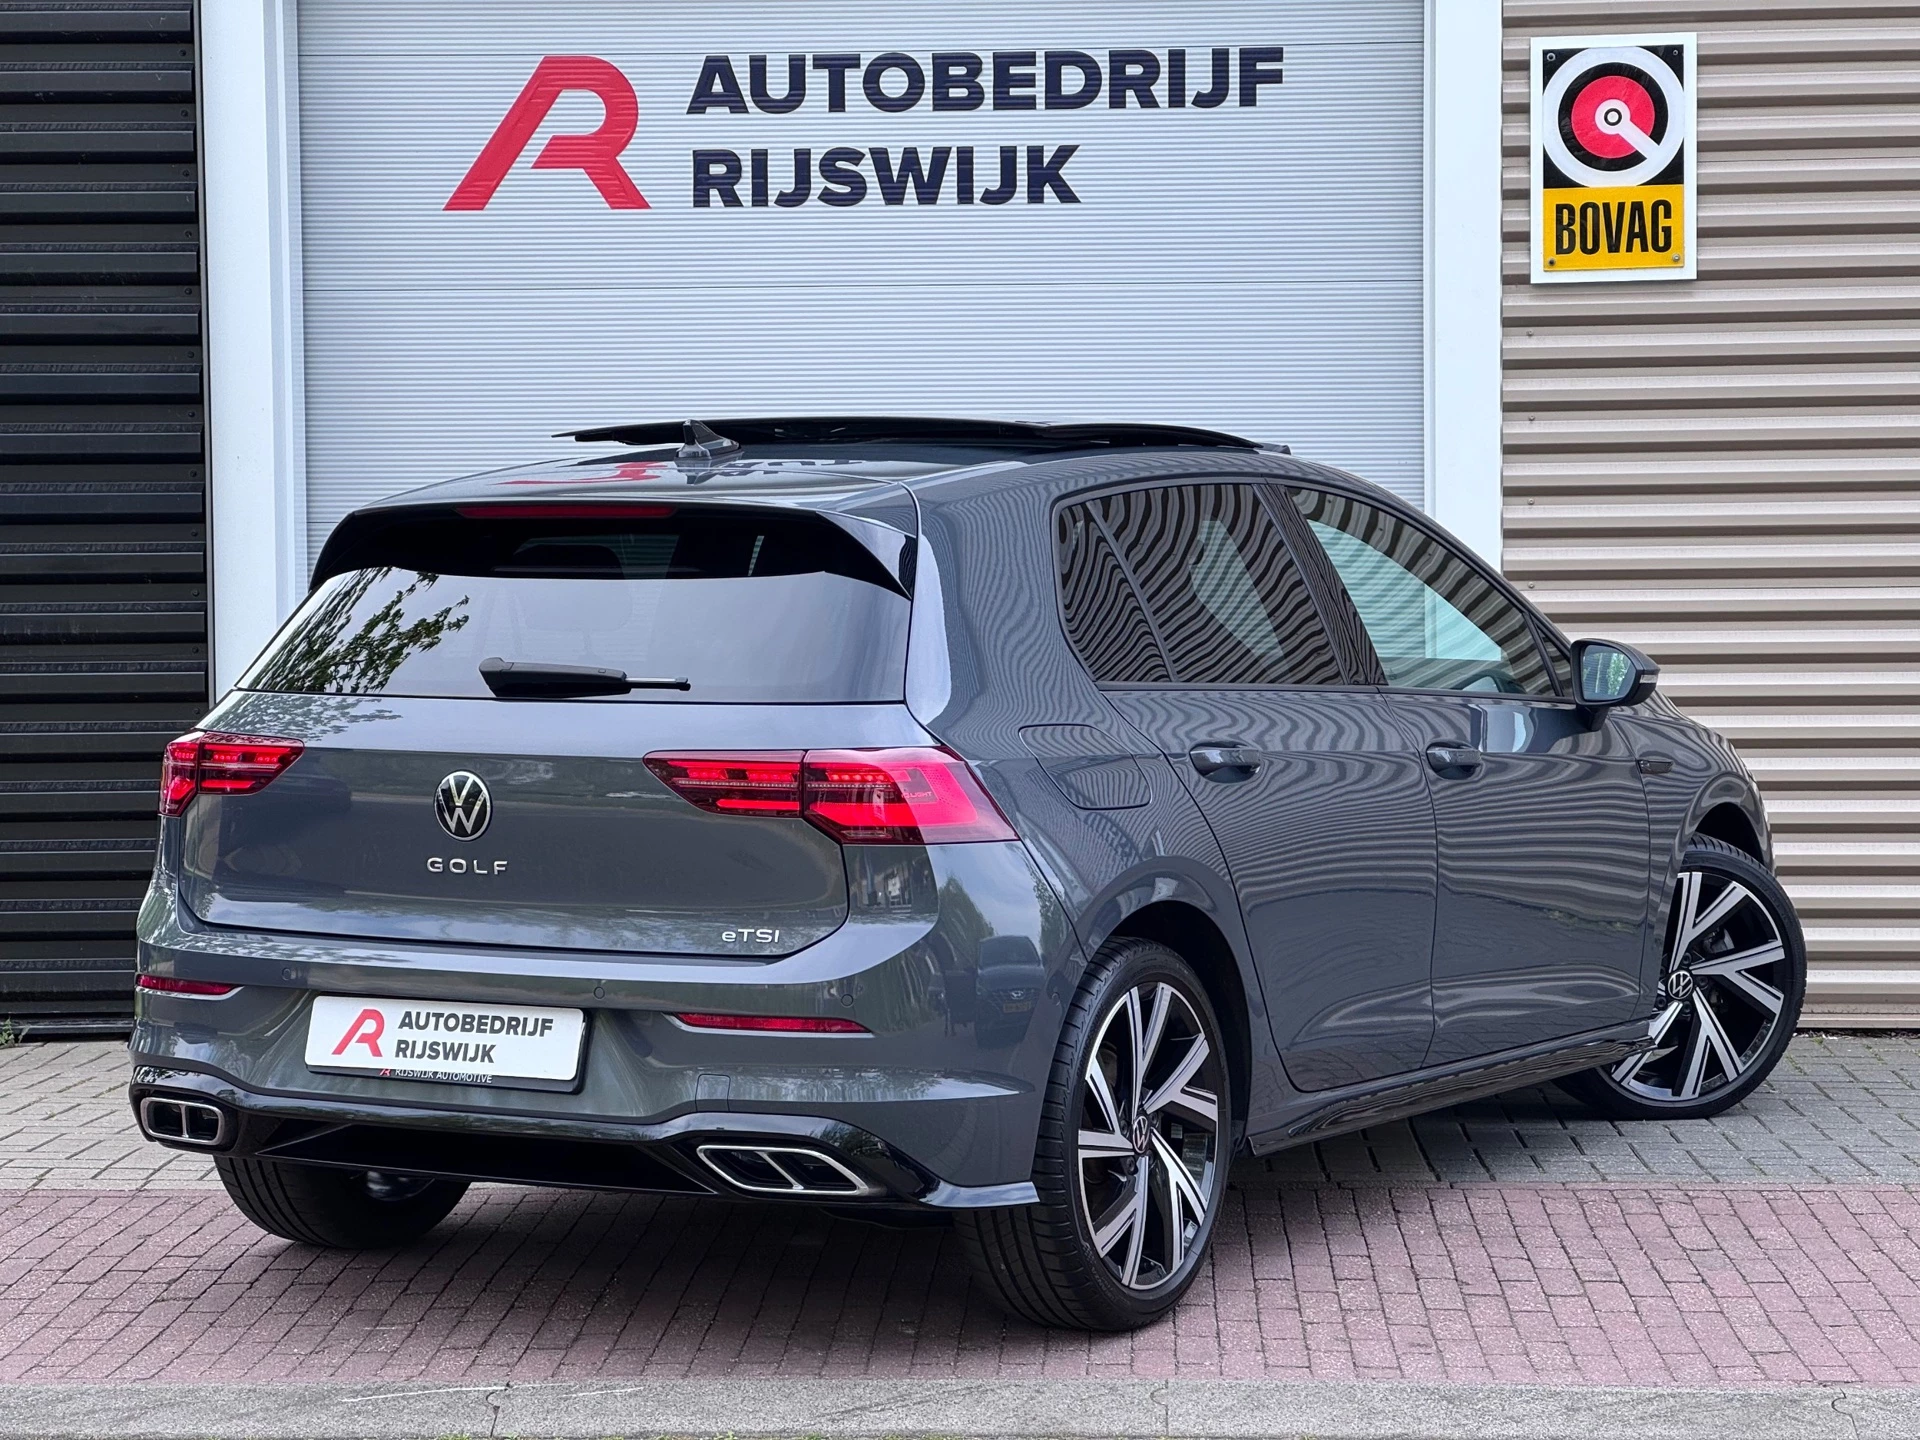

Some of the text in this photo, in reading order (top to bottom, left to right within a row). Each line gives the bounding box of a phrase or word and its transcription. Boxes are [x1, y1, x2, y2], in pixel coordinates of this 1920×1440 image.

[686, 47, 1284, 115] AUTOBEDRIJF
[692, 145, 1082, 208] RIJSWIJK
[1555, 199, 1672, 256] BOVAG
[426, 857, 508, 875] GOLF
[721, 928, 780, 943] eTSI
[397, 1010, 554, 1038] AUTOBEDRIJF
[394, 1039, 497, 1064] RIJSWIJK
[435, 1071, 493, 1084] AUTOMOTIVE
